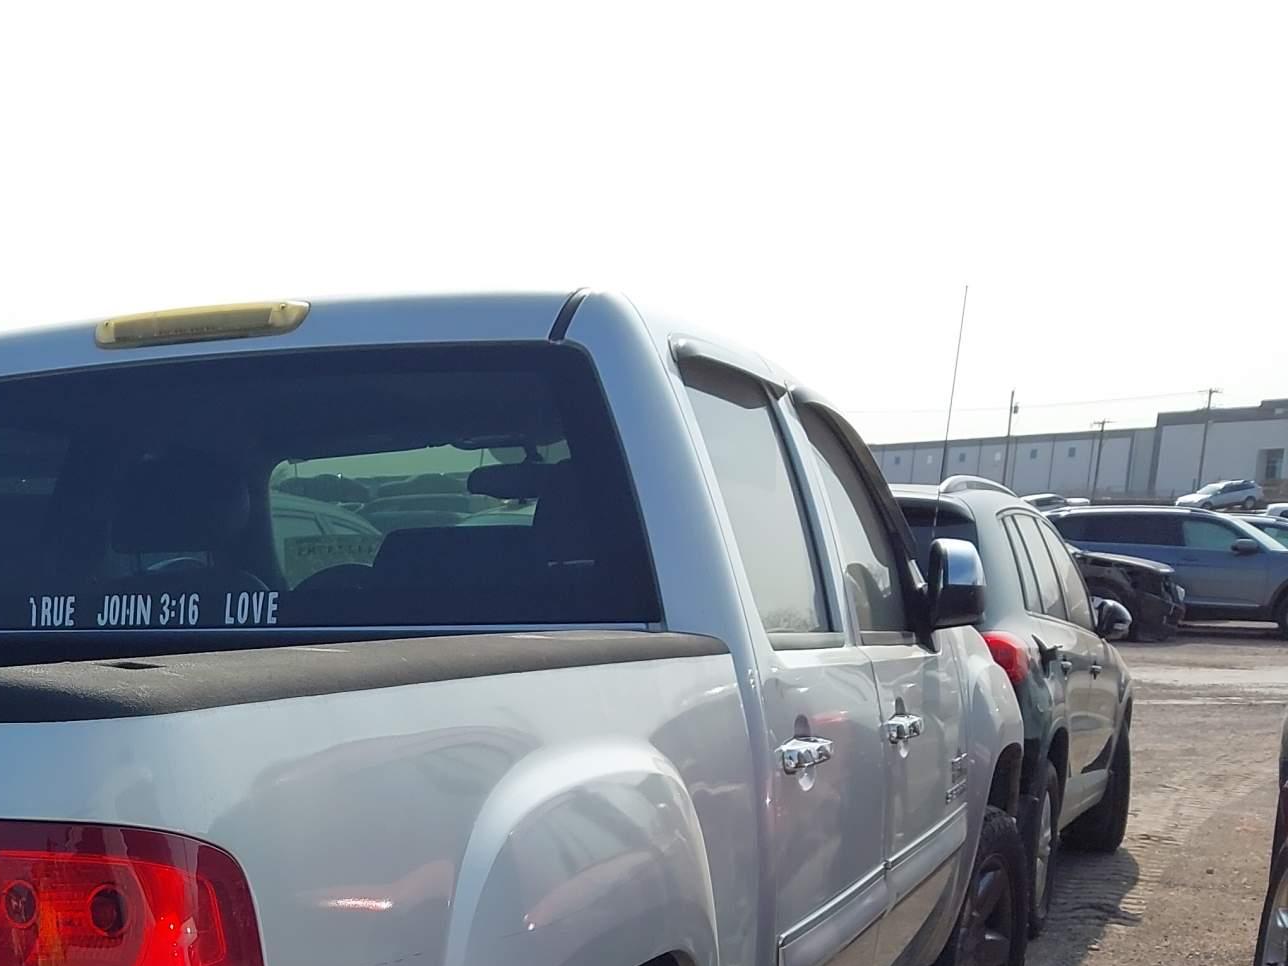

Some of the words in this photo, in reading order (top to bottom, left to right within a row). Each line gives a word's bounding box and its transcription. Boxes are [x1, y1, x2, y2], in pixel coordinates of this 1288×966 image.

[97, 594, 152, 627] JOHN
[159, 592, 200, 626] 3:16
[224, 591, 279, 625] LOVE
